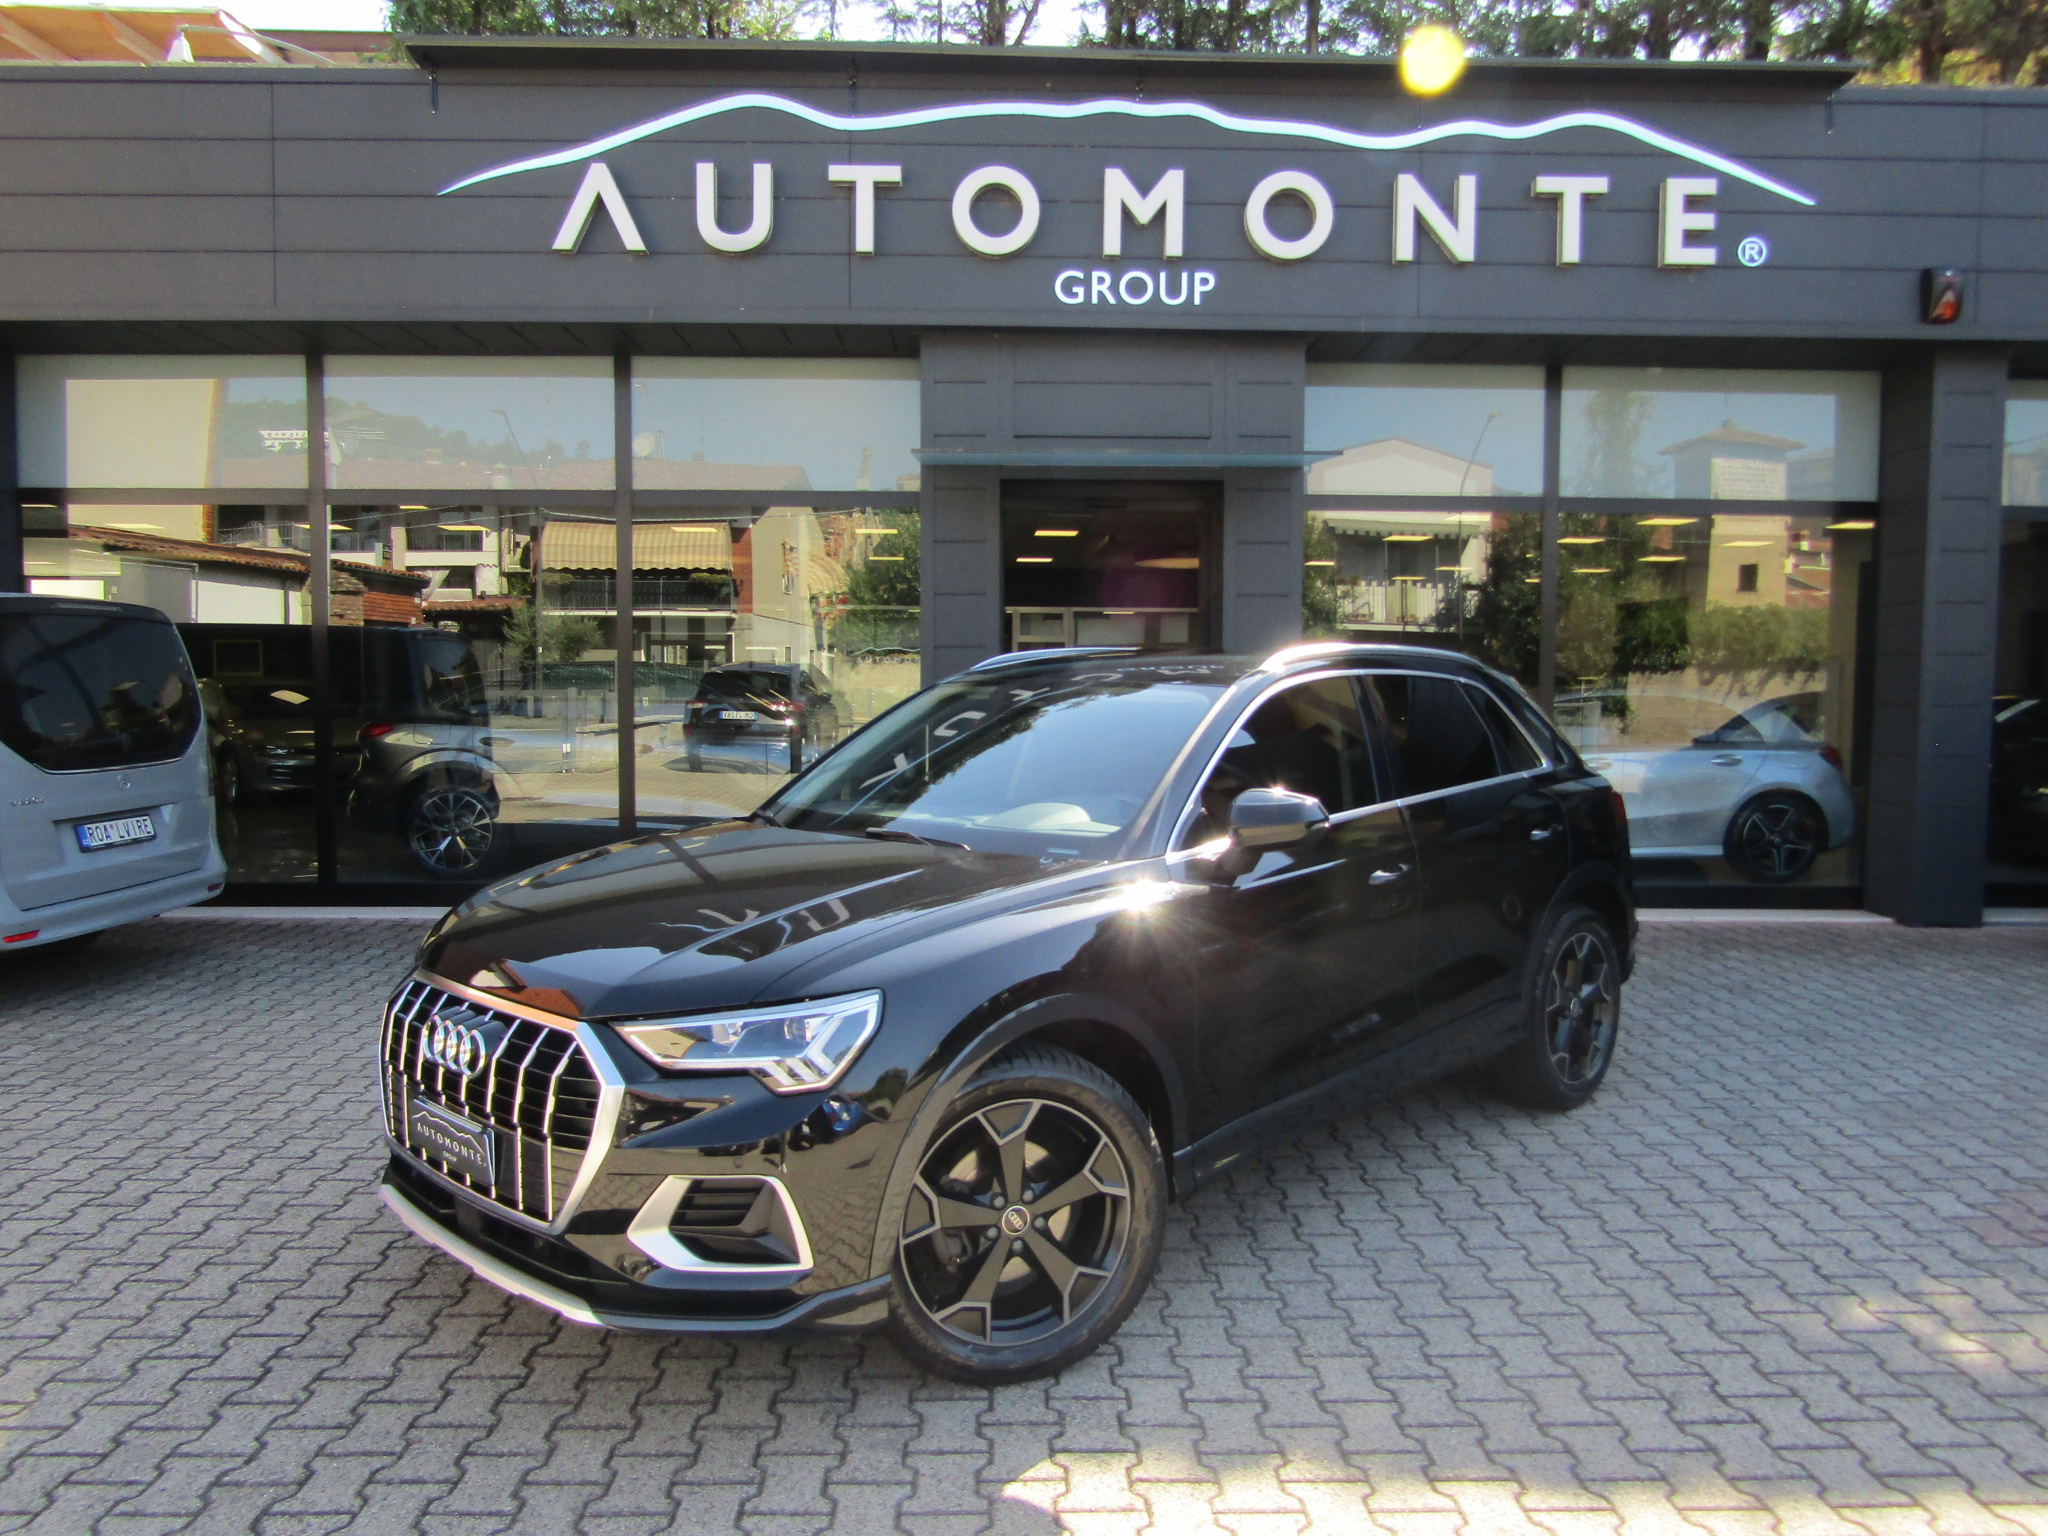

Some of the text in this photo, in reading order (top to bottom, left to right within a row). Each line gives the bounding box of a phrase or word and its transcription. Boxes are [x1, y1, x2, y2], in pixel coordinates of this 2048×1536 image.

[552, 161, 1719, 268] AUTOMONTE
[1054, 270, 1216, 306] GROUP
[417, 1122, 484, 1165] AUTOMONTE
